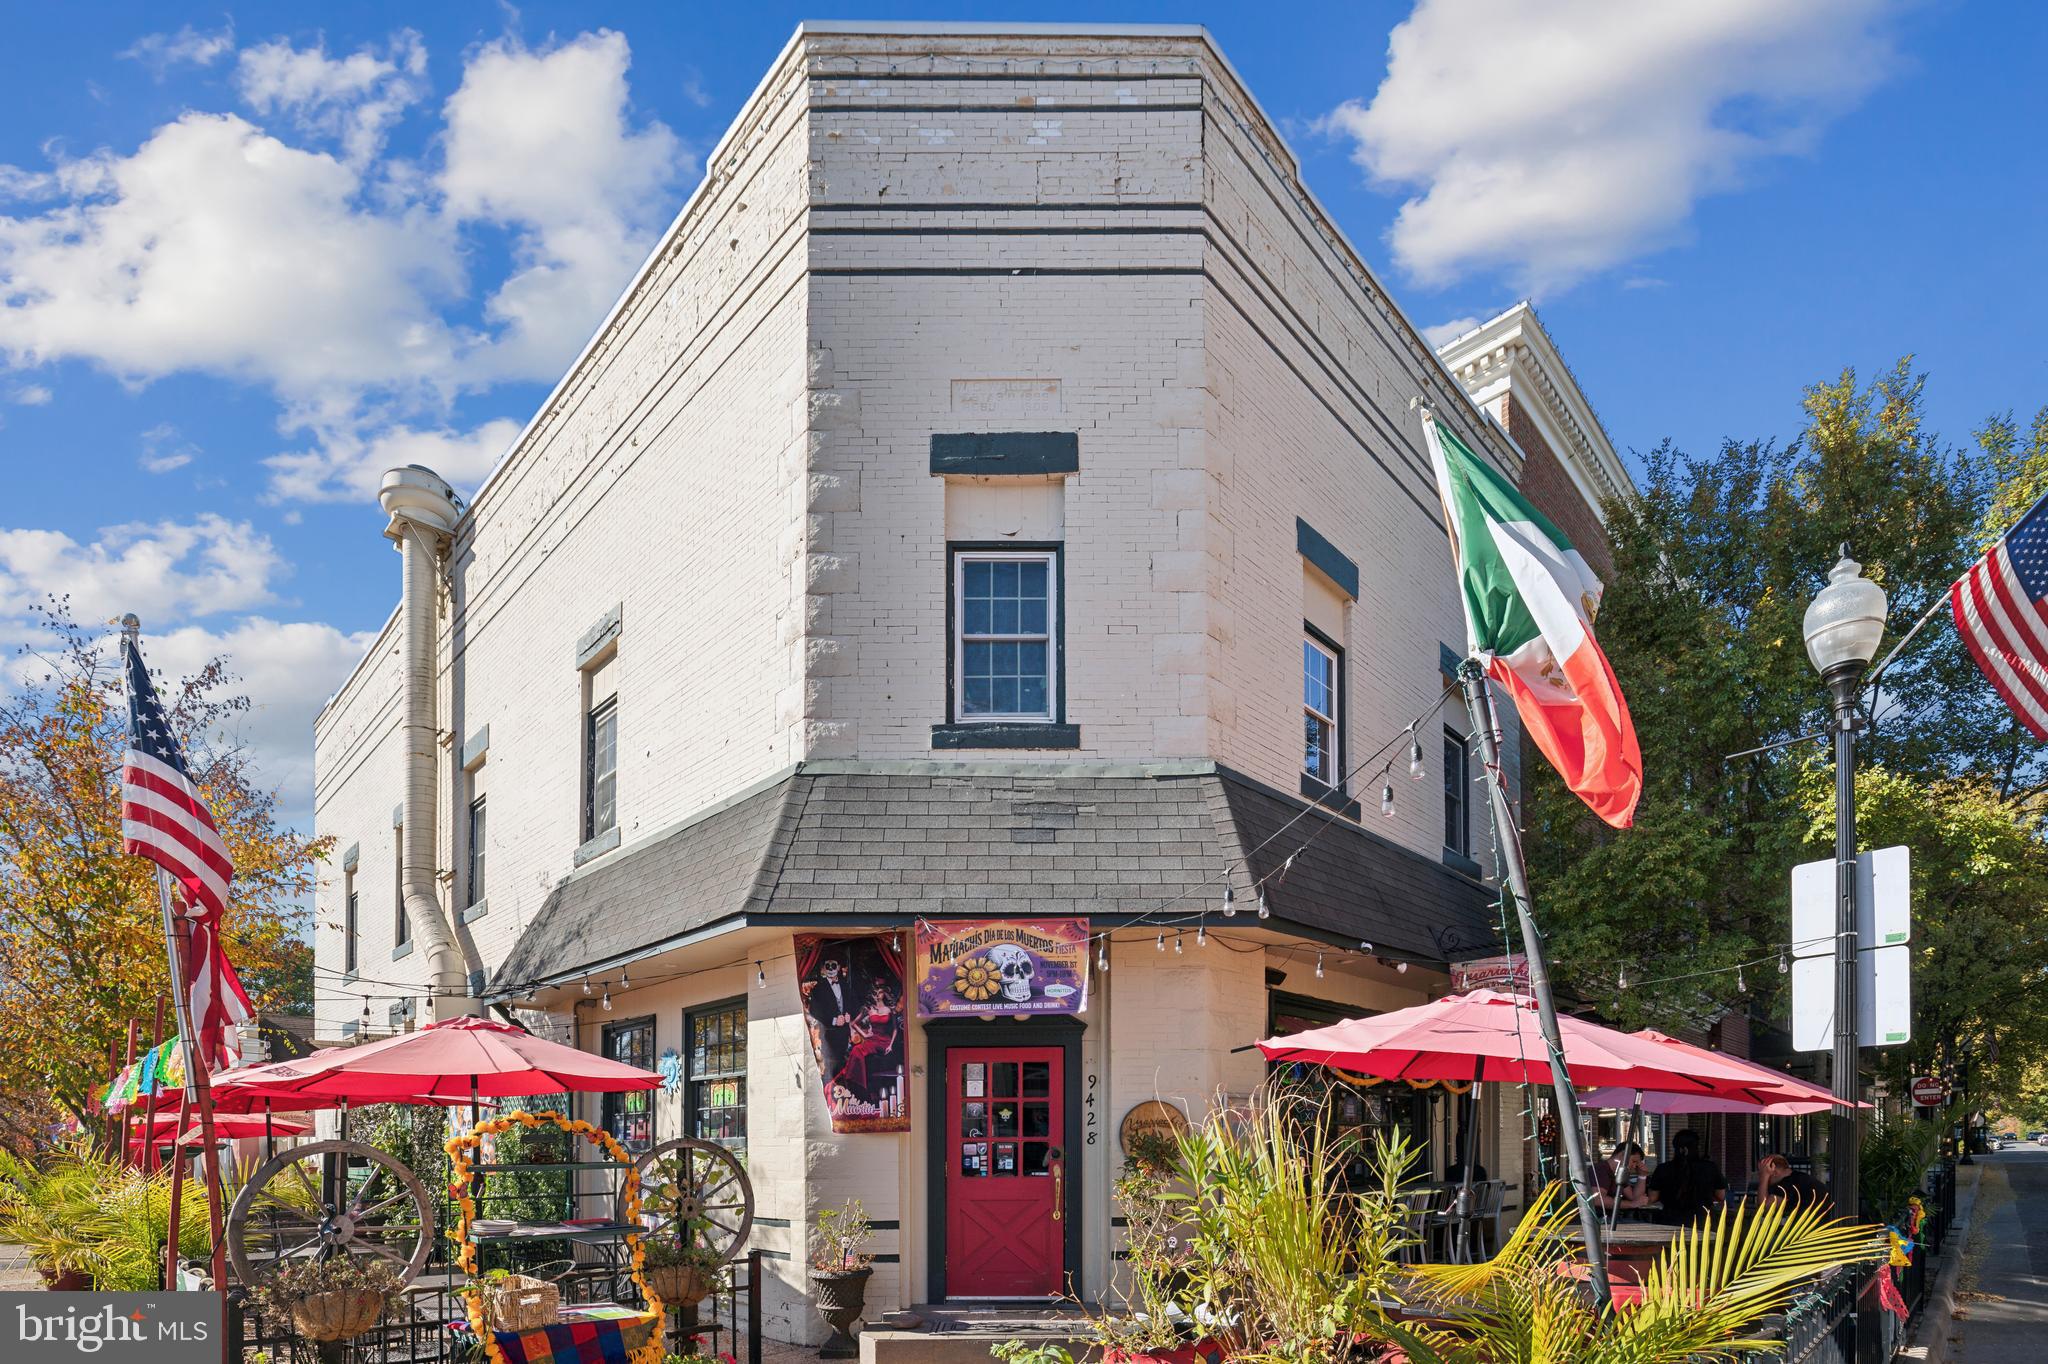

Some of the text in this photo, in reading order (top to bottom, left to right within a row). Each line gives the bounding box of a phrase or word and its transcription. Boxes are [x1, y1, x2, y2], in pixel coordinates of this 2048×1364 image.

[1005, 929, 1015, 940] LOS
[1015, 928, 1054, 953] MUERTOS
[1056, 942, 1077, 955] FIESTA
[1040, 960, 1068, 969] NOVEMBER
[971, 1003, 992, 1011] CONTEST
[1085, 1074, 1098, 1145] 9428
